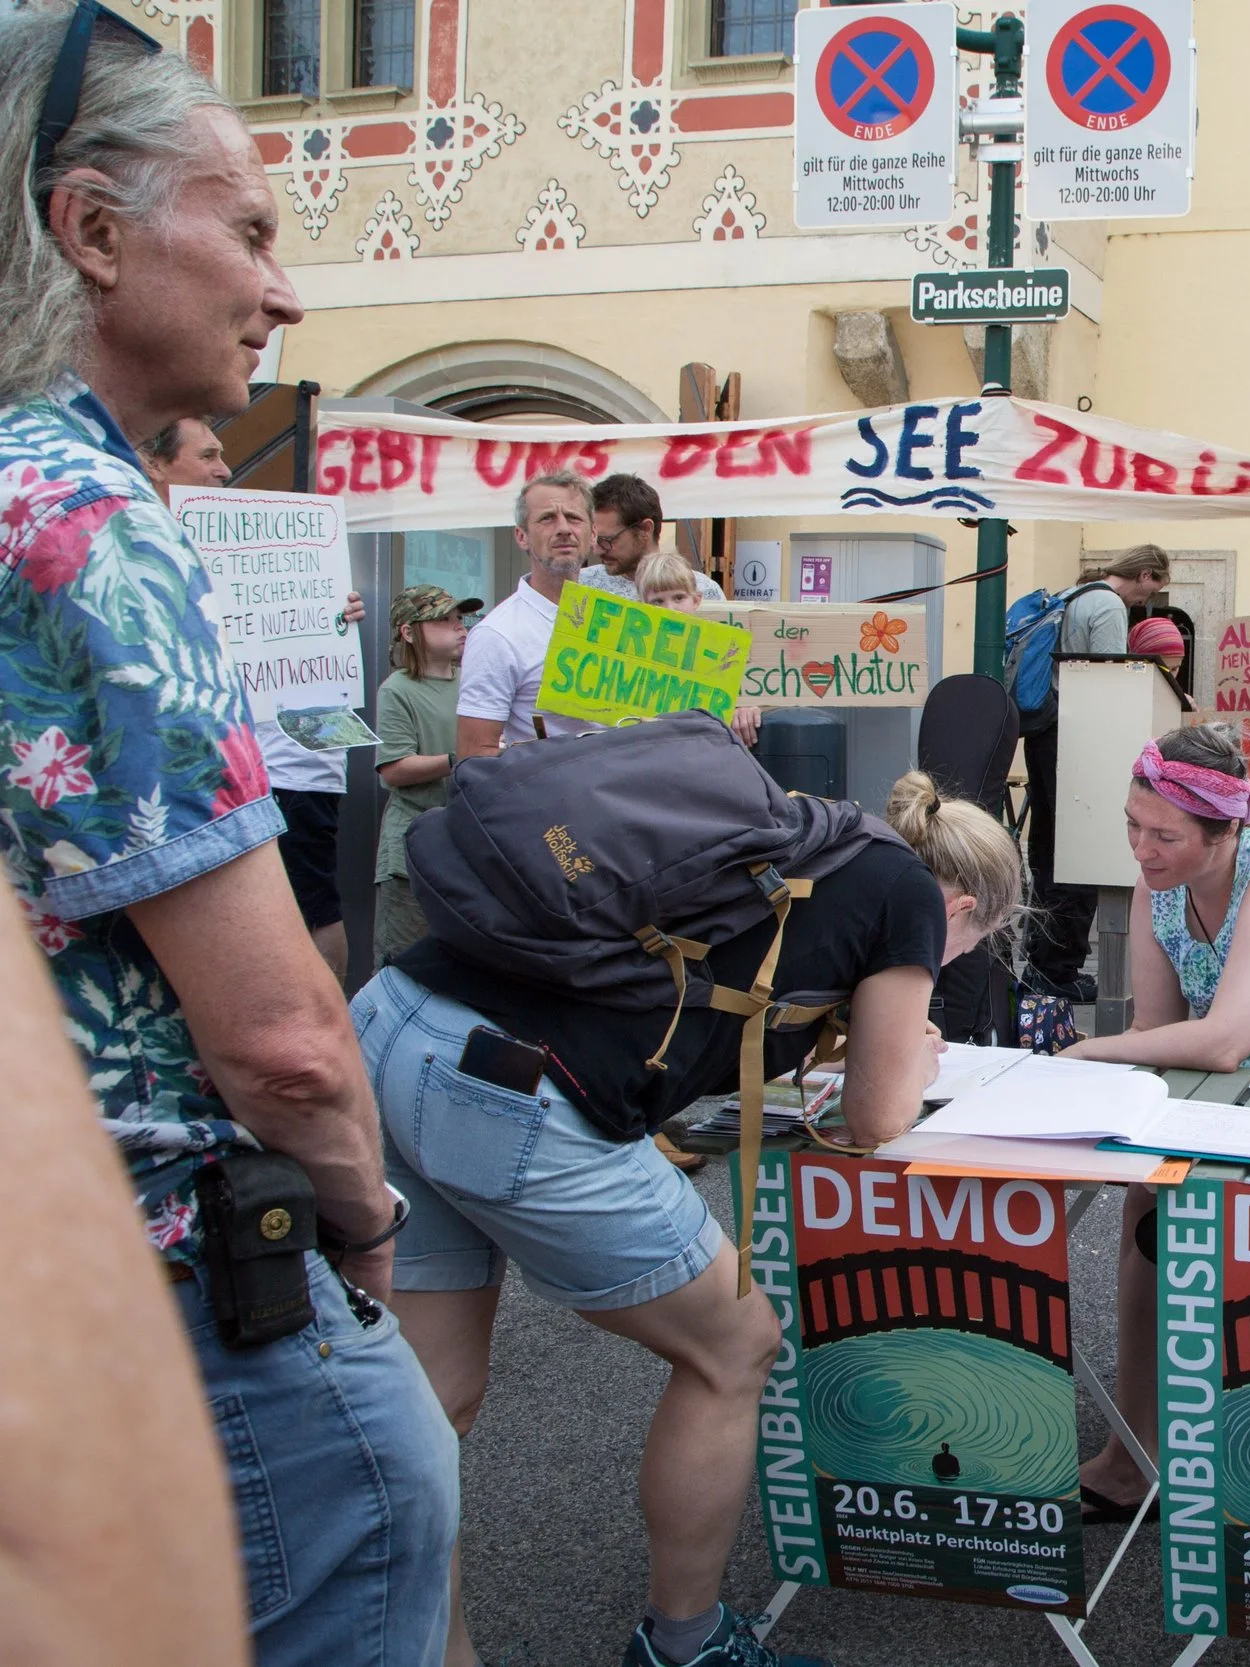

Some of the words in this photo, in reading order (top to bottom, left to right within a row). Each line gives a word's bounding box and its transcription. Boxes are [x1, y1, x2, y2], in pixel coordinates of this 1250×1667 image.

[854, 123, 895, 141] ENDE
[1086, 113, 1130, 131] ENDE
[803, 157, 824, 175] gilt
[827, 156, 845, 173] für
[849, 154, 868, 171] die
[872, 157, 908, 175] ganze
[912, 152, 945, 168] Reihe
[1034, 147, 1055, 165] gilt
[1059, 147, 1078, 163] für
[1082, 145, 1101, 161] die
[1105, 148, 1142, 165] ganze
[1147, 143, 1182, 160] Reihe
[843, 174, 904, 191] Mittwochs
[1075, 165, 1139, 183] Mittwochs
[827, 196, 896, 213] 12:00-20:00
[900, 194, 920, 211] Uhr
[1059, 187, 1130, 204] 12:00-20:00
[1134, 186, 1156, 202] Uhr
[918, 279, 1063, 310] Parkscheine
[317, 427, 452, 496] GEBT
[472, 438, 616, 487] UNS
[657, 426, 818, 481] DEN
[845, 402, 983, 480] SEE
[182, 510, 326, 543] STEINBRUCHSEE
[228, 550, 321, 575] TEUFELSTEIN
[262, 607, 330, 636] NUTZUNG
[587, 598, 719, 672] FREI-
[774, 619, 810, 640] der
[738, 649, 801, 697] sch
[834, 650, 920, 697] Natur
[553, 824, 578, 853] Jack
[543, 828, 578, 882] Wolfskin
[801, 1164, 1056, 1248] DEMO
[1167, 1190, 1220, 1629] STEINBRUCHSEE
[833, 1484, 929, 1521] 20.6.
[953, 1495, 1064, 1534] 17:30
[837, 1523, 931, 1546] Marktplatz
[936, 1533, 1067, 1559] Perchtoldsdorf
